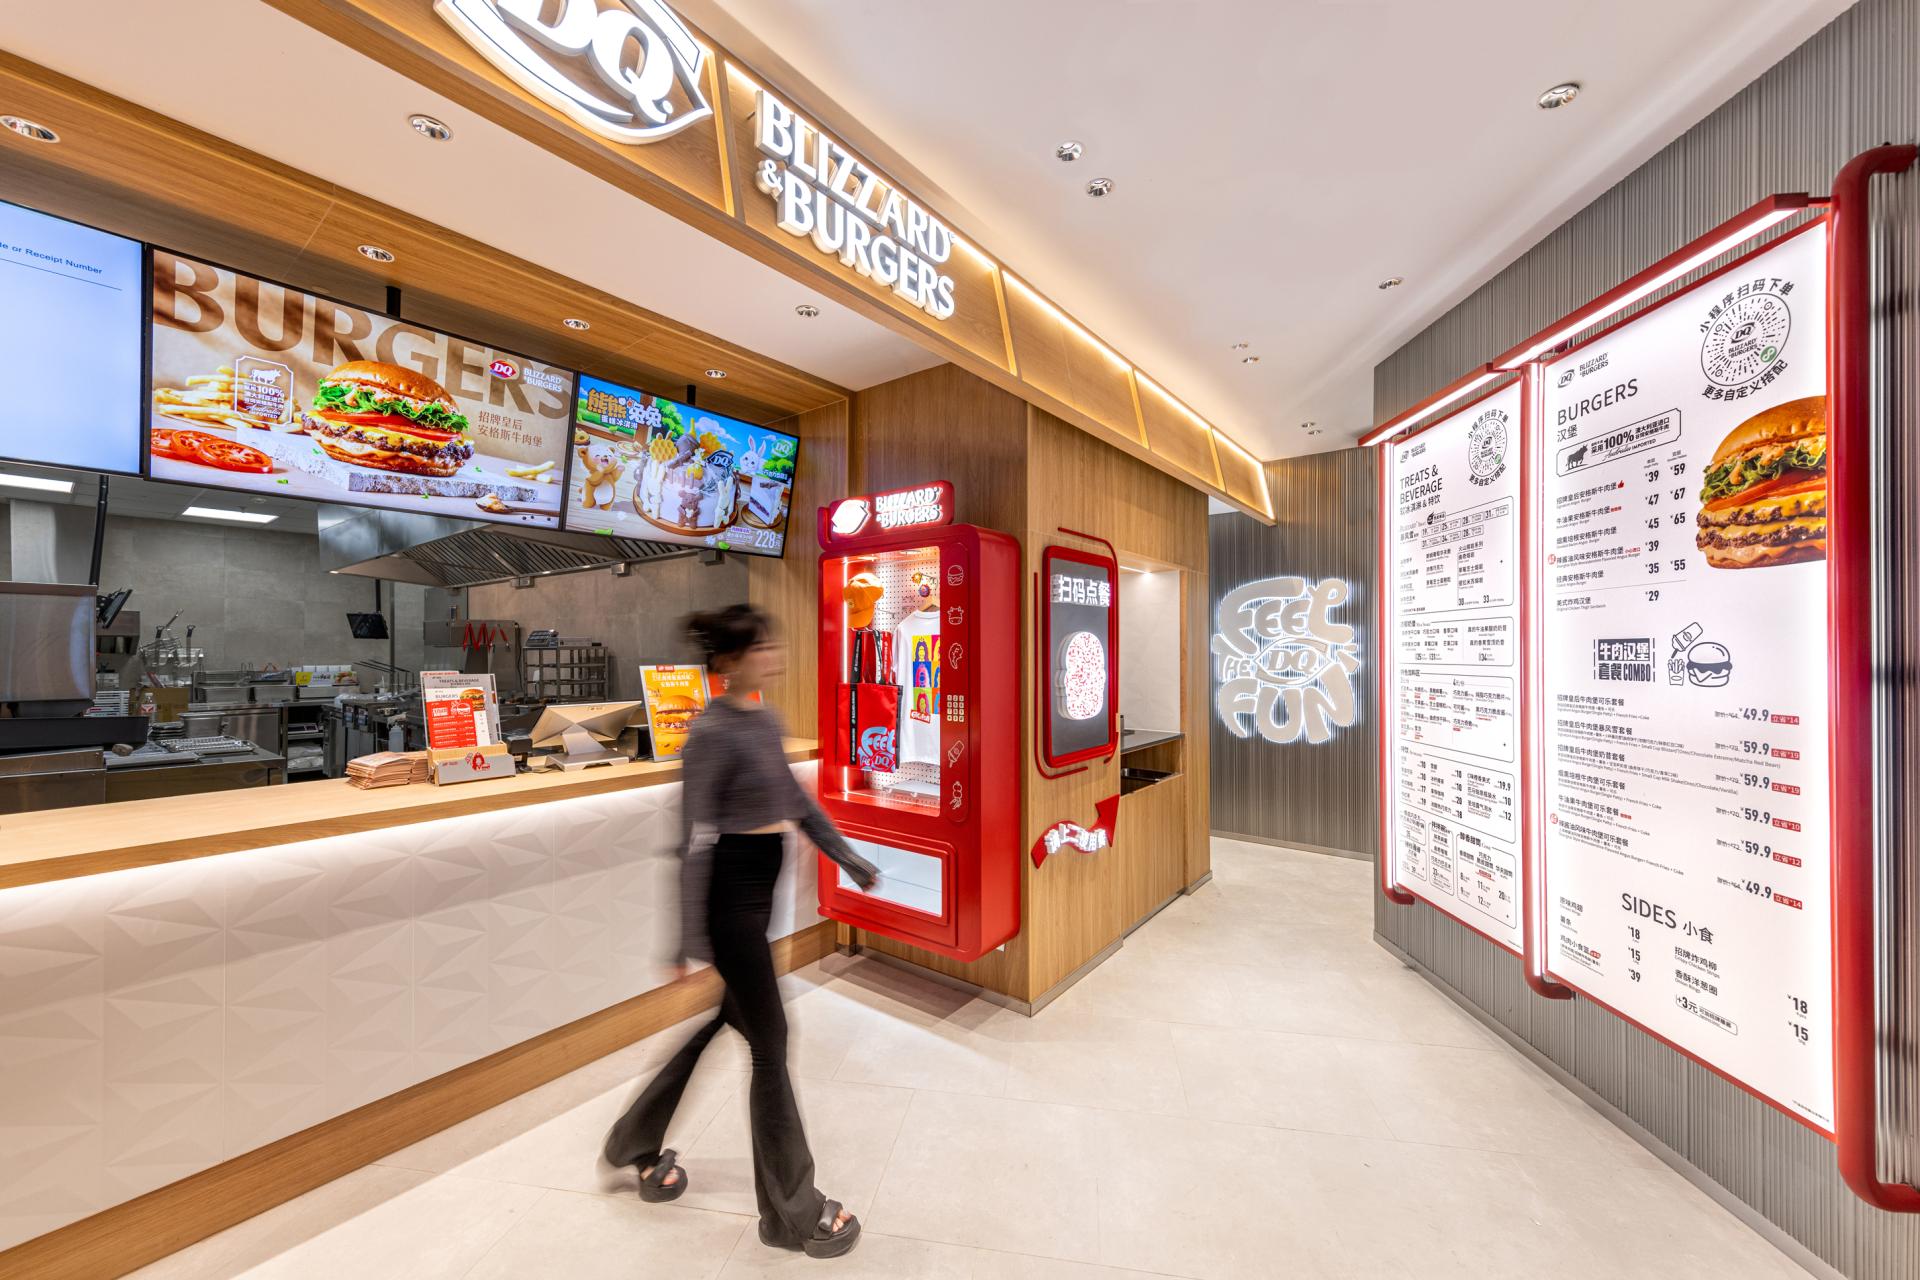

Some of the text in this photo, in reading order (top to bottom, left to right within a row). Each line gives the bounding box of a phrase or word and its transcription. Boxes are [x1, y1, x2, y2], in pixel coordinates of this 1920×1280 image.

[755, 90, 954, 265] BLIZZARD
[25, 248, 63, 264] Receipt
[65, 259, 103, 275] Number
[1699, 277, 1795, 334] 小程序扫码下单
[153, 249, 570, 420] BURGERS
[1702, 358, 1789, 402] 更多自定义搭配
[1557, 378, 1639, 426] BURGERS
[478, 410, 524, 431] 招牌皇后
[1556, 424, 1578, 443] 汉堡
[477, 424, 544, 448] 安格斯牛肉堡
[1603, 430, 1635, 450] 100%
[1631, 438, 1657, 450] IMPORTED
[1400, 467, 1430, 490] TREATS
[1400, 478, 1443, 505] BEVERAGE
[755, 530, 776, 549] 228
[1058, 574, 1110, 607] 扫码点餐
[1599, 640, 1651, 662] 牛肉汉堡
[1598, 663, 1651, 682] 套餐 COMBO
[1217, 663, 1356, 744] FUN
[1621, 892, 1714, 945] SIDES 小食
[1674, 946, 1718, 972] 招牌炸鸡柳
[1675, 968, 1718, 997] 香酥洋葱圈
